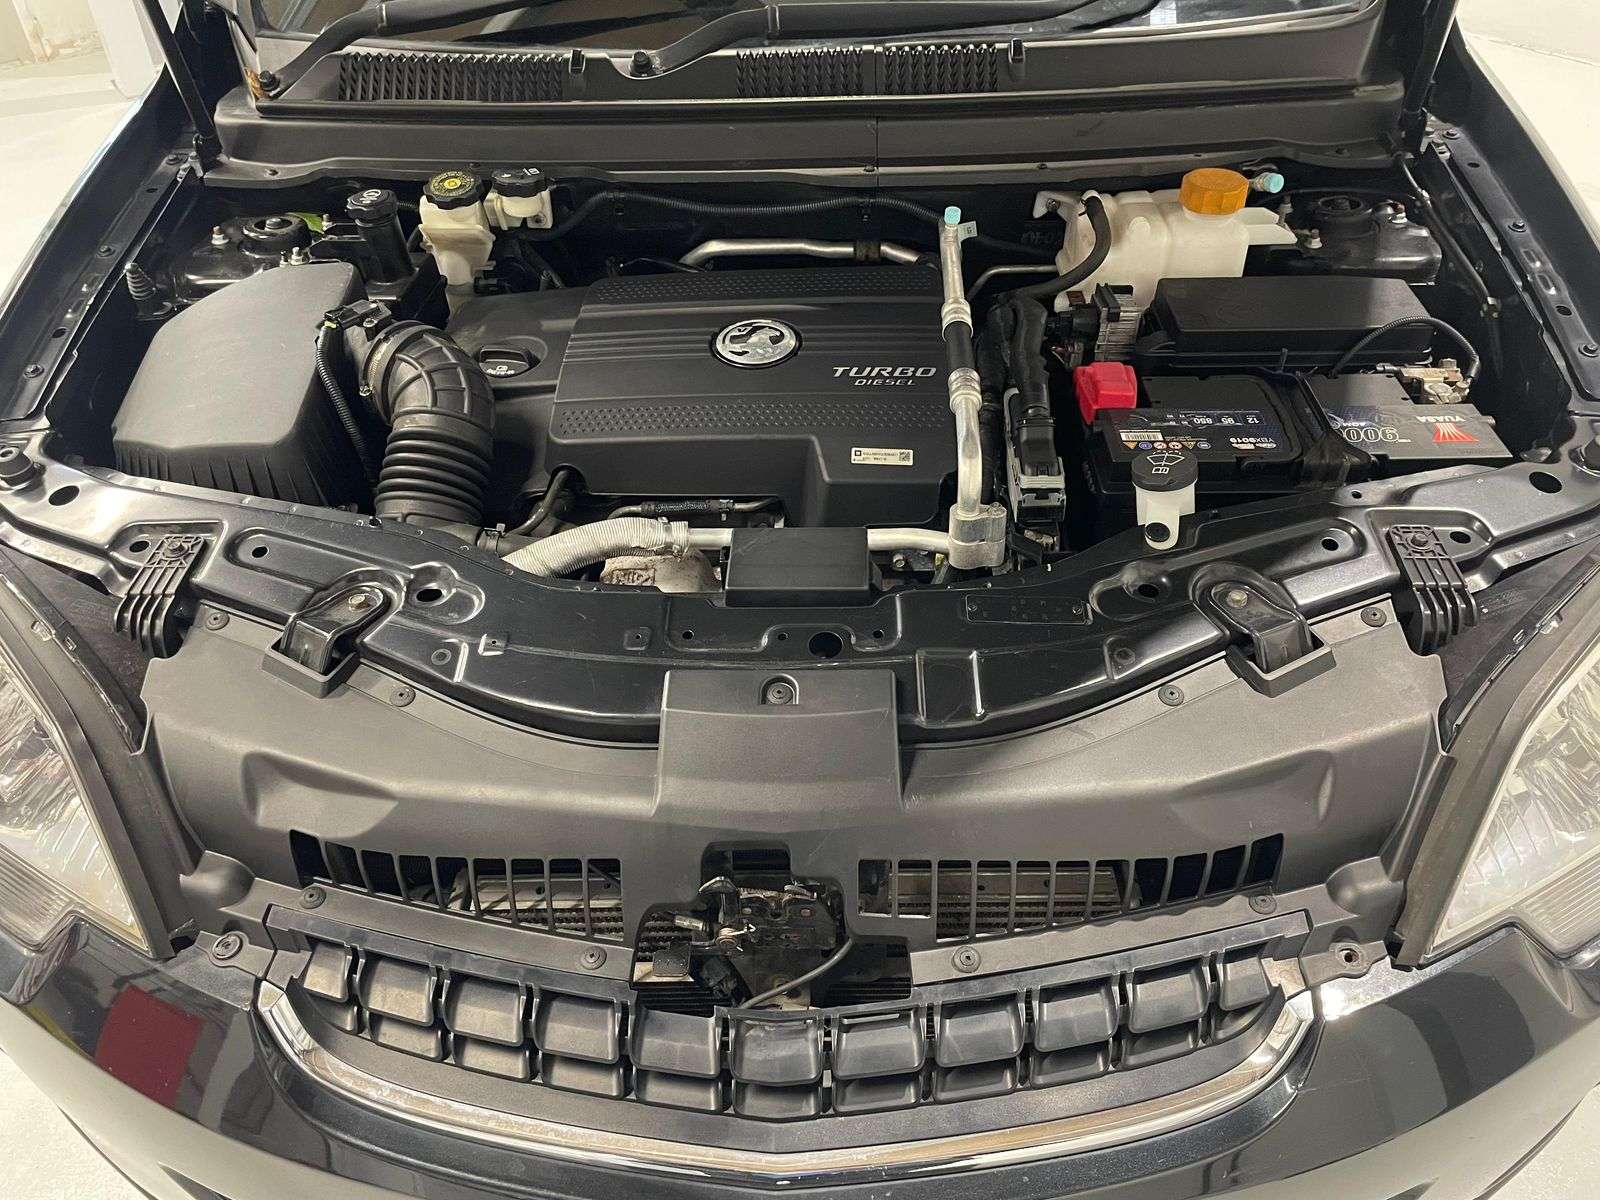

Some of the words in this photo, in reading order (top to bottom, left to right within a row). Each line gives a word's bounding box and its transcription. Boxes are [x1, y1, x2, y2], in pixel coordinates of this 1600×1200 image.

[832, 366, 937, 377] TURBO
[854, 378, 916, 386] DIESEL
[1415, 415, 1467, 423] YUASA
